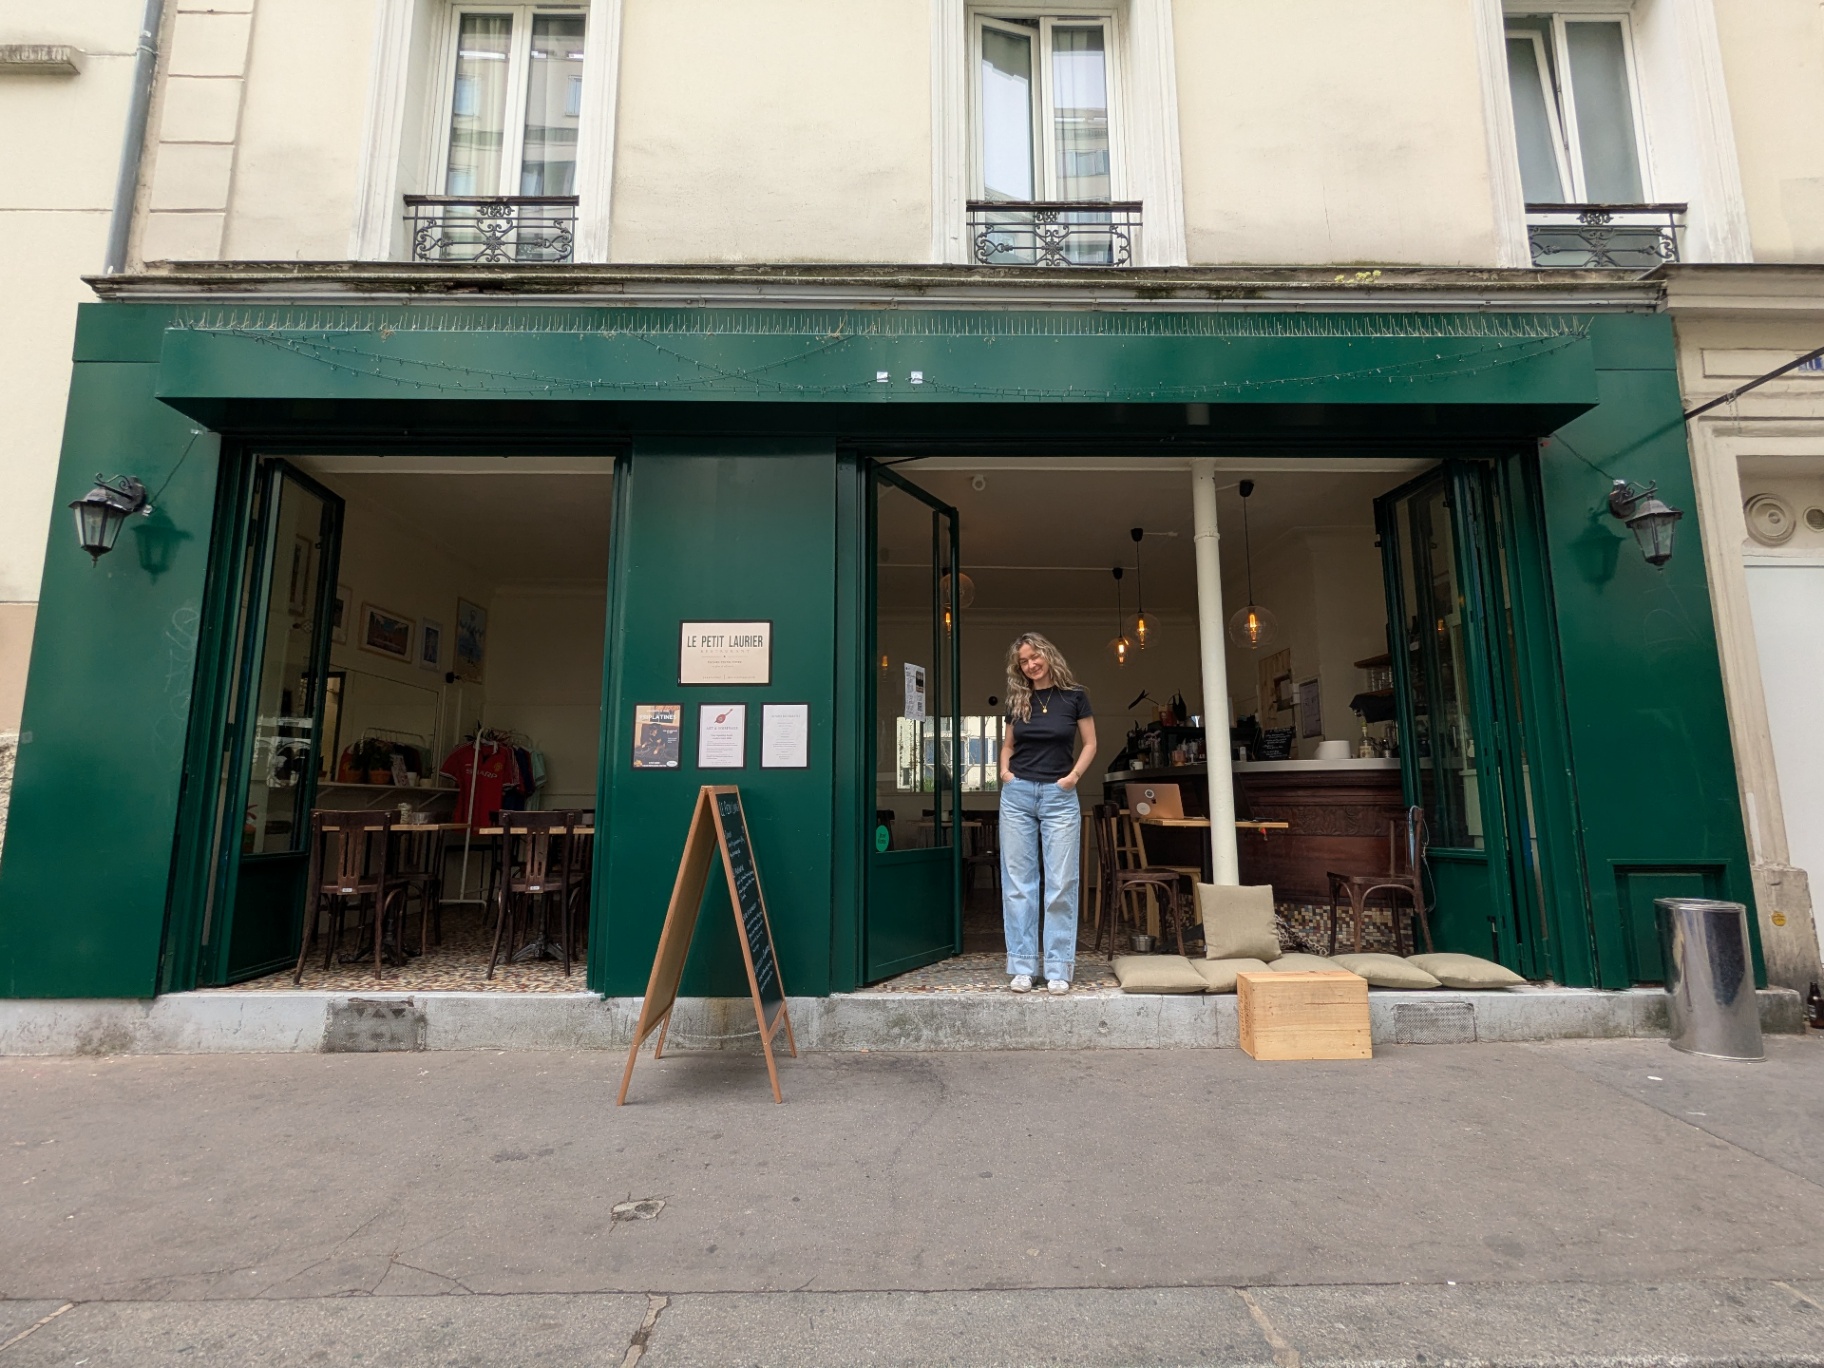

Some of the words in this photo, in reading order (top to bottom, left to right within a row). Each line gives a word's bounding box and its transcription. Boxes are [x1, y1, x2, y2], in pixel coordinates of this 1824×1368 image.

[687, 635, 697, 648] LE
[701, 635, 725, 648] PETIT
[728, 635, 763, 648] LAURIER
